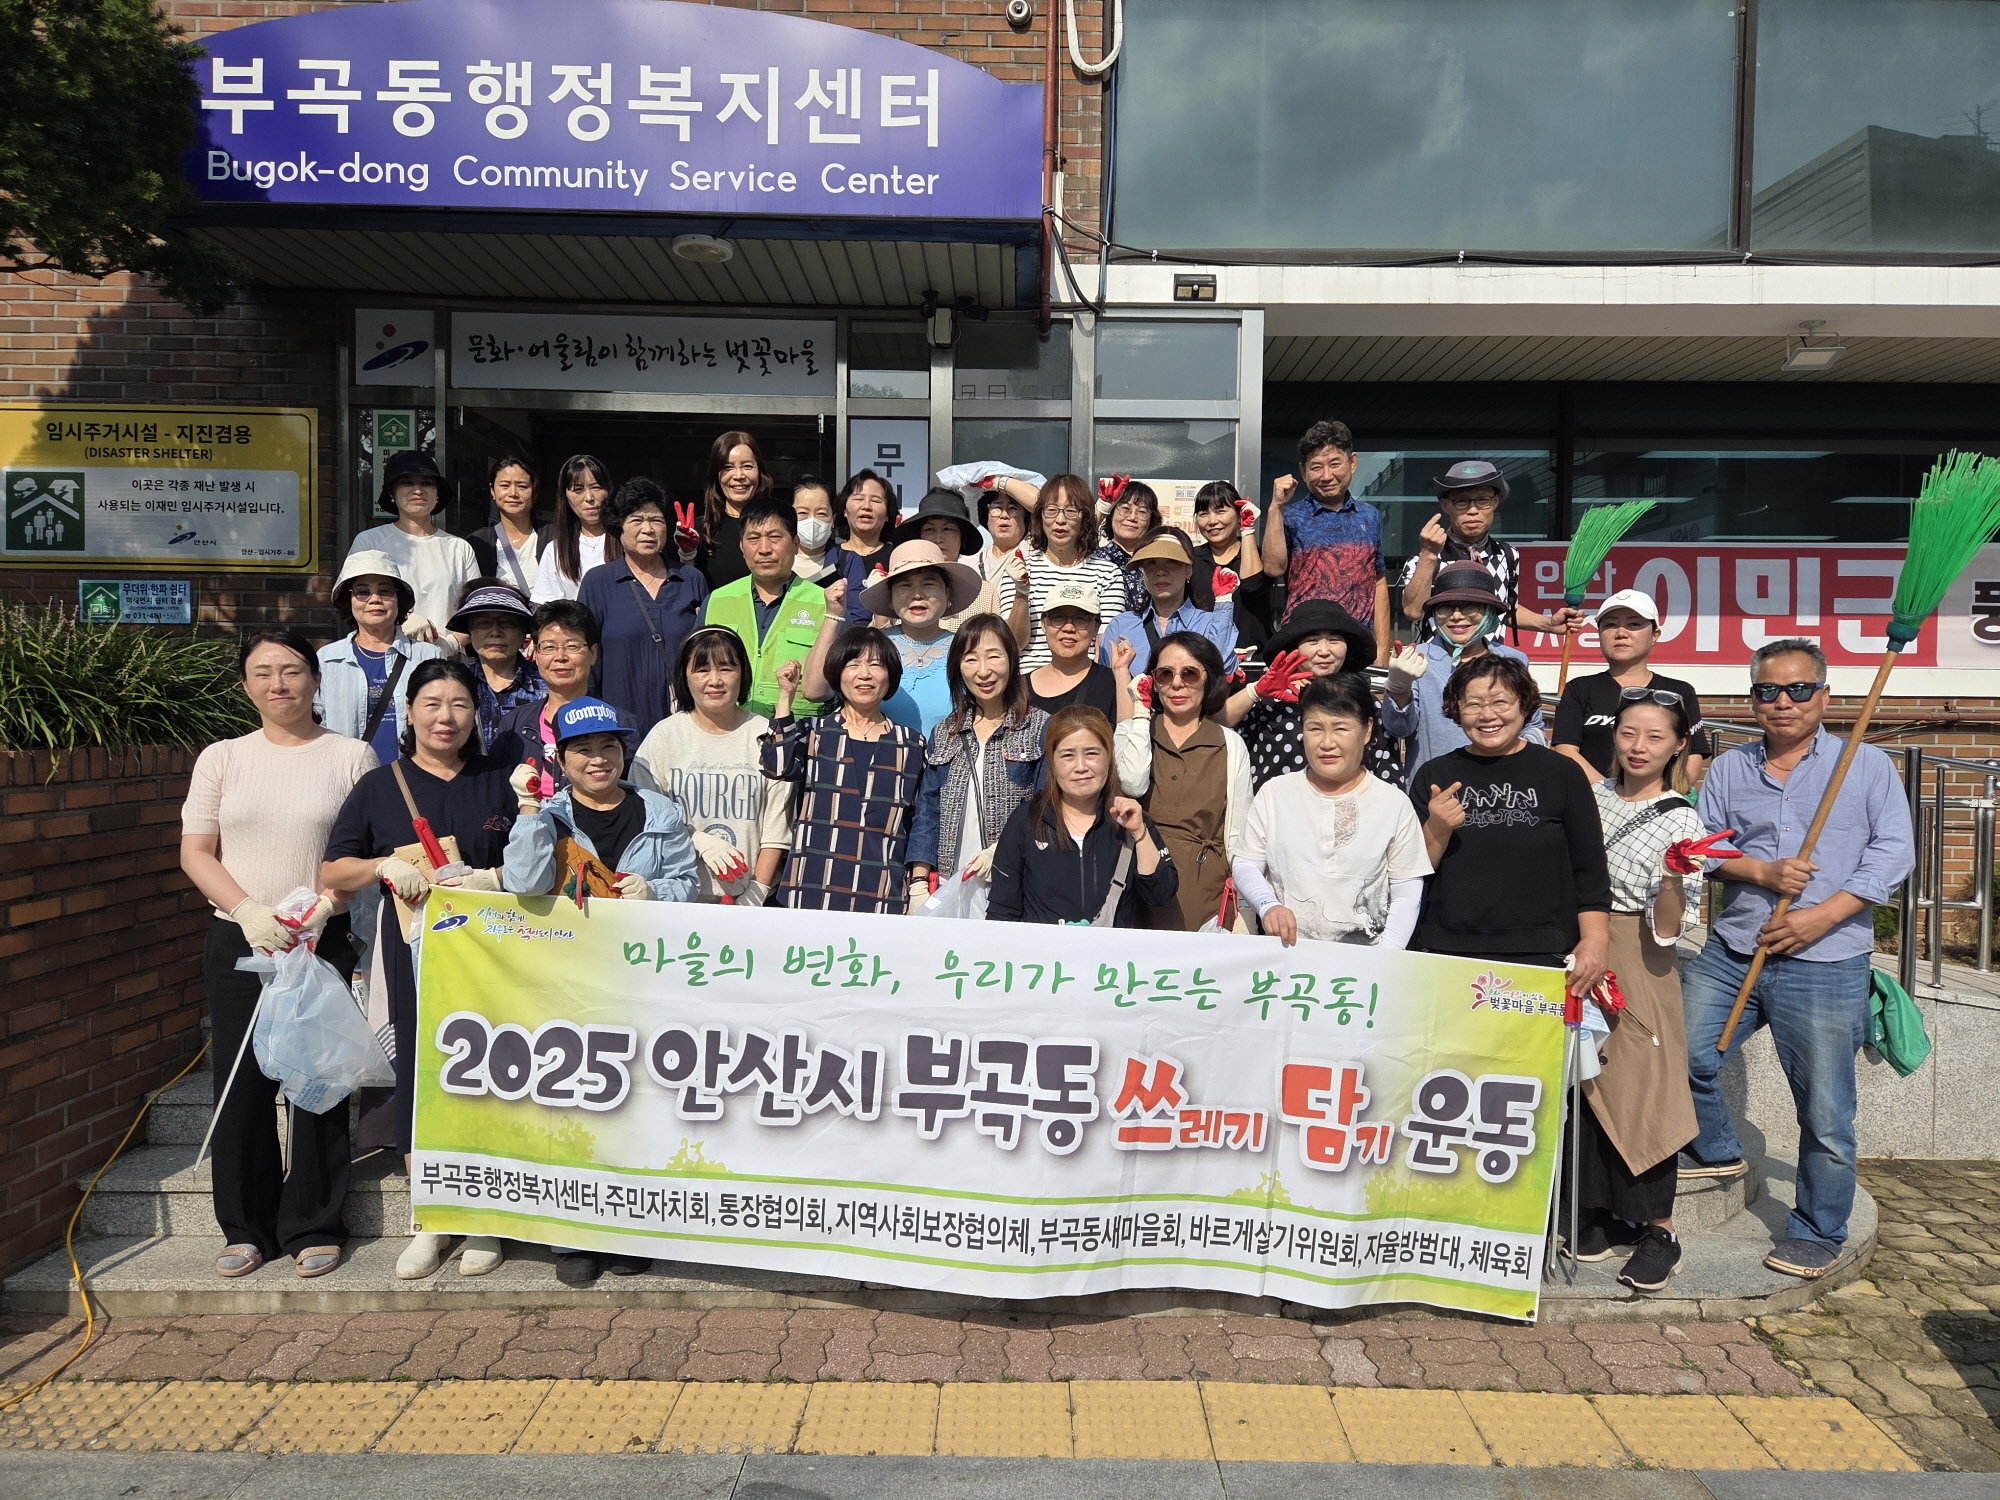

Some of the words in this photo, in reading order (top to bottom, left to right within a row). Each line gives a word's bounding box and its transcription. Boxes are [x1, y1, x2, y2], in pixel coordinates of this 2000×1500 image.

[201, 57, 939, 147] 부곡동행정복지센터
[207, 150, 430, 192] Bugok-dong
[453, 155, 648, 196] Community
[669, 159, 797, 194] Service
[821, 163, 940, 196] Center
[625, 333, 717, 371] 함께하는
[46, 421, 158, 442] 임시주거시설
[176, 423, 252, 445] 지진겸용
[84, 446, 150, 460] (DISASTER
[153, 447, 213, 461] SHELTER)
[131, 479, 164, 491] 이곳은
[168, 480, 190, 492] 각종
[193, 480, 216, 492] 재난
[219, 481, 241, 492] 발생
[244, 481, 255, 493] 시
[98, 500, 142, 512] 사용되는
[145, 500, 178, 513] 이재민
[181, 500, 285, 514] 임시주거시설입니다.
[122, 583, 168, 596] 무더위·한파
[169, 583, 187, 596] 쉼터
[1631, 556, 1918, 655] 이민근
[564, 703, 618, 725] Compton
[623, 931, 754, 987] 마을의
[782, 936, 901, 995] 변화,
[934, 949, 1075, 1000] 우리가
[1093, 960, 1222, 1011] 만드는
[1242, 970, 1379, 1029] 부곡동!
[438, 1014, 634, 1107] 2025
[648, 1027, 883, 1122] 안산시
[897, 1030, 1098, 1151] 부곡동
[1111, 1054, 1266, 1150] 쓰레기
[1278, 1060, 1392, 1169] 담기
[1405, 1072, 1540, 1179] 운동
[1468, 1239, 1533, 1280] 체육회
